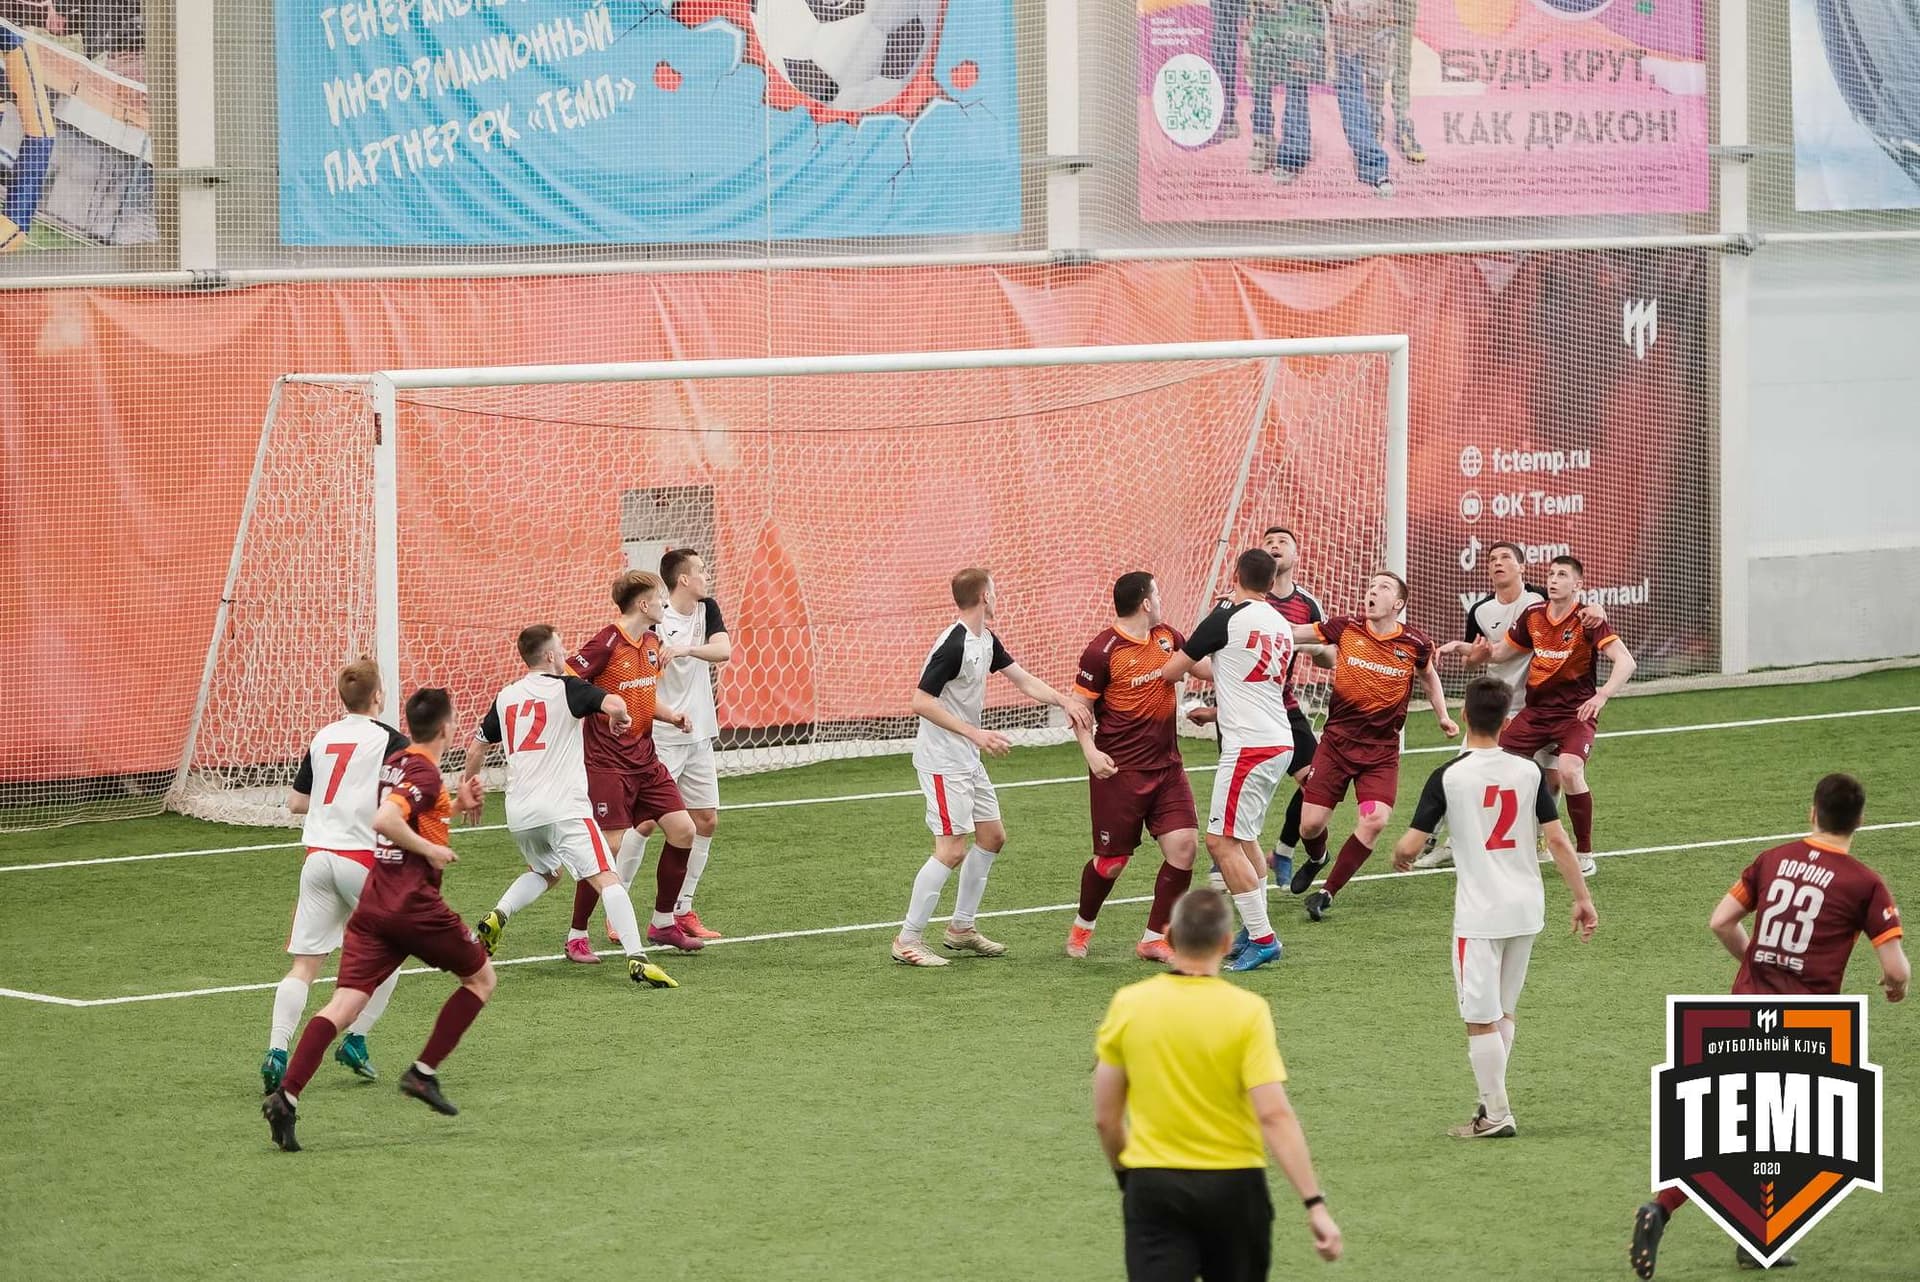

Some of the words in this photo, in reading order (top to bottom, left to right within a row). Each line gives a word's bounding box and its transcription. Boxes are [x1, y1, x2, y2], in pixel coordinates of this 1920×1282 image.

[323, 1, 614, 126] ИНФОРМАЦИОННЫЙ
[1440, 48, 1552, 90] БУДЬ
[1563, 48, 1656, 90] КРУТ,
[323, 120, 460, 195] ПАРТНЕР
[468, 103, 520, 153] ФК
[528, 74, 636, 134] «ТЕМП»
[1443, 110, 1515, 145] КАК
[1525, 109, 1677, 151] ДРАКОН!
[1492, 447, 1591, 476] fctemp.ru
[1492, 492, 1525, 519] ФК
[1528, 490, 1584, 519] Темп
[505, 699, 546, 755] 12
[324, 743, 358, 804] 7
[1483, 784, 1518, 850] 2
[374, 847, 403, 861] EUS
[1776, 858, 1835, 889] ВОРОНА
[1757, 878, 1825, 954] 23
[1753, 950, 1805, 972] SEUS
